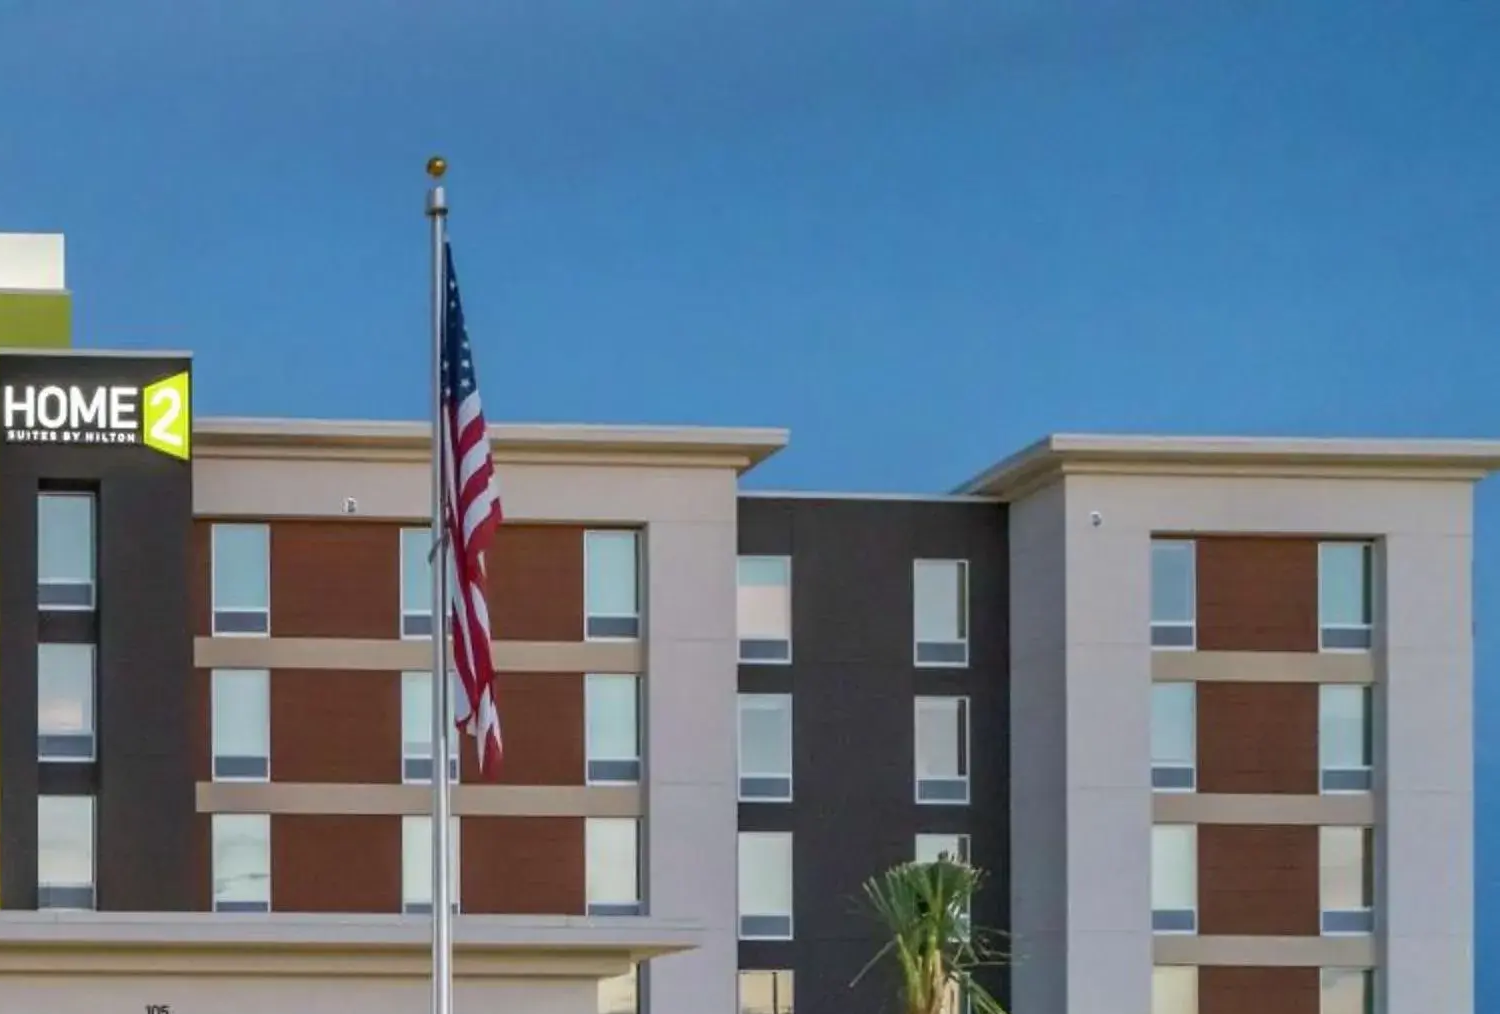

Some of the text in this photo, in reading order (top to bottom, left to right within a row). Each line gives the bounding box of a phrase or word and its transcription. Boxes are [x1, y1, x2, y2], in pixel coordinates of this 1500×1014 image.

[4, 385, 184, 446] HOME 2
[7, 430, 136, 443] SUITES BY HILTON
